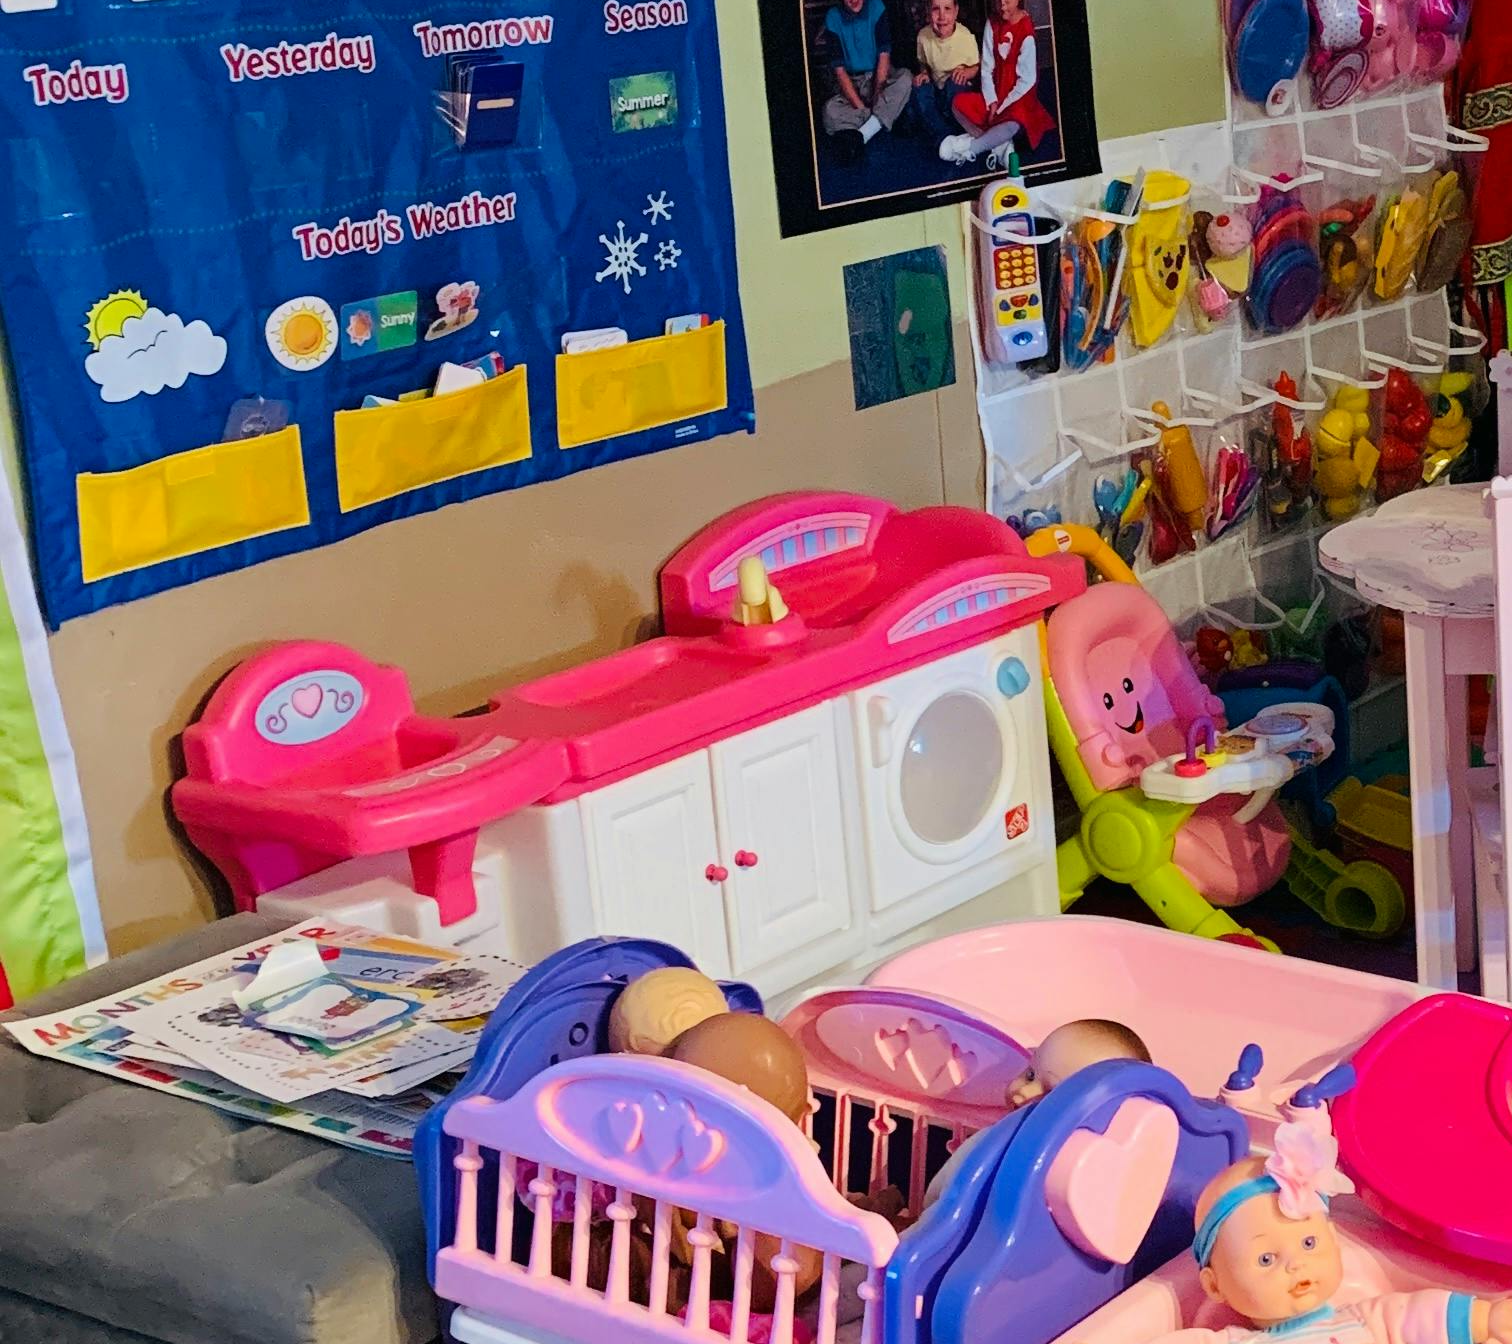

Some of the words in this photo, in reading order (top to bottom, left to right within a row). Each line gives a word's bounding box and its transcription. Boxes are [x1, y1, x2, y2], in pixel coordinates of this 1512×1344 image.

[28, 61, 128, 106] Today
[221, 33, 376, 81] Yesterday
[414, 14, 554, 57] Tomorrow
[603, 0, 688, 35] Season
[617, 89, 670, 115] Summer
[295, 215, 404, 262] Today's
[411, 190, 517, 240] Weather
[380, 307, 417, 332] Sunny
[33, 978, 203, 1046] MONTHS
